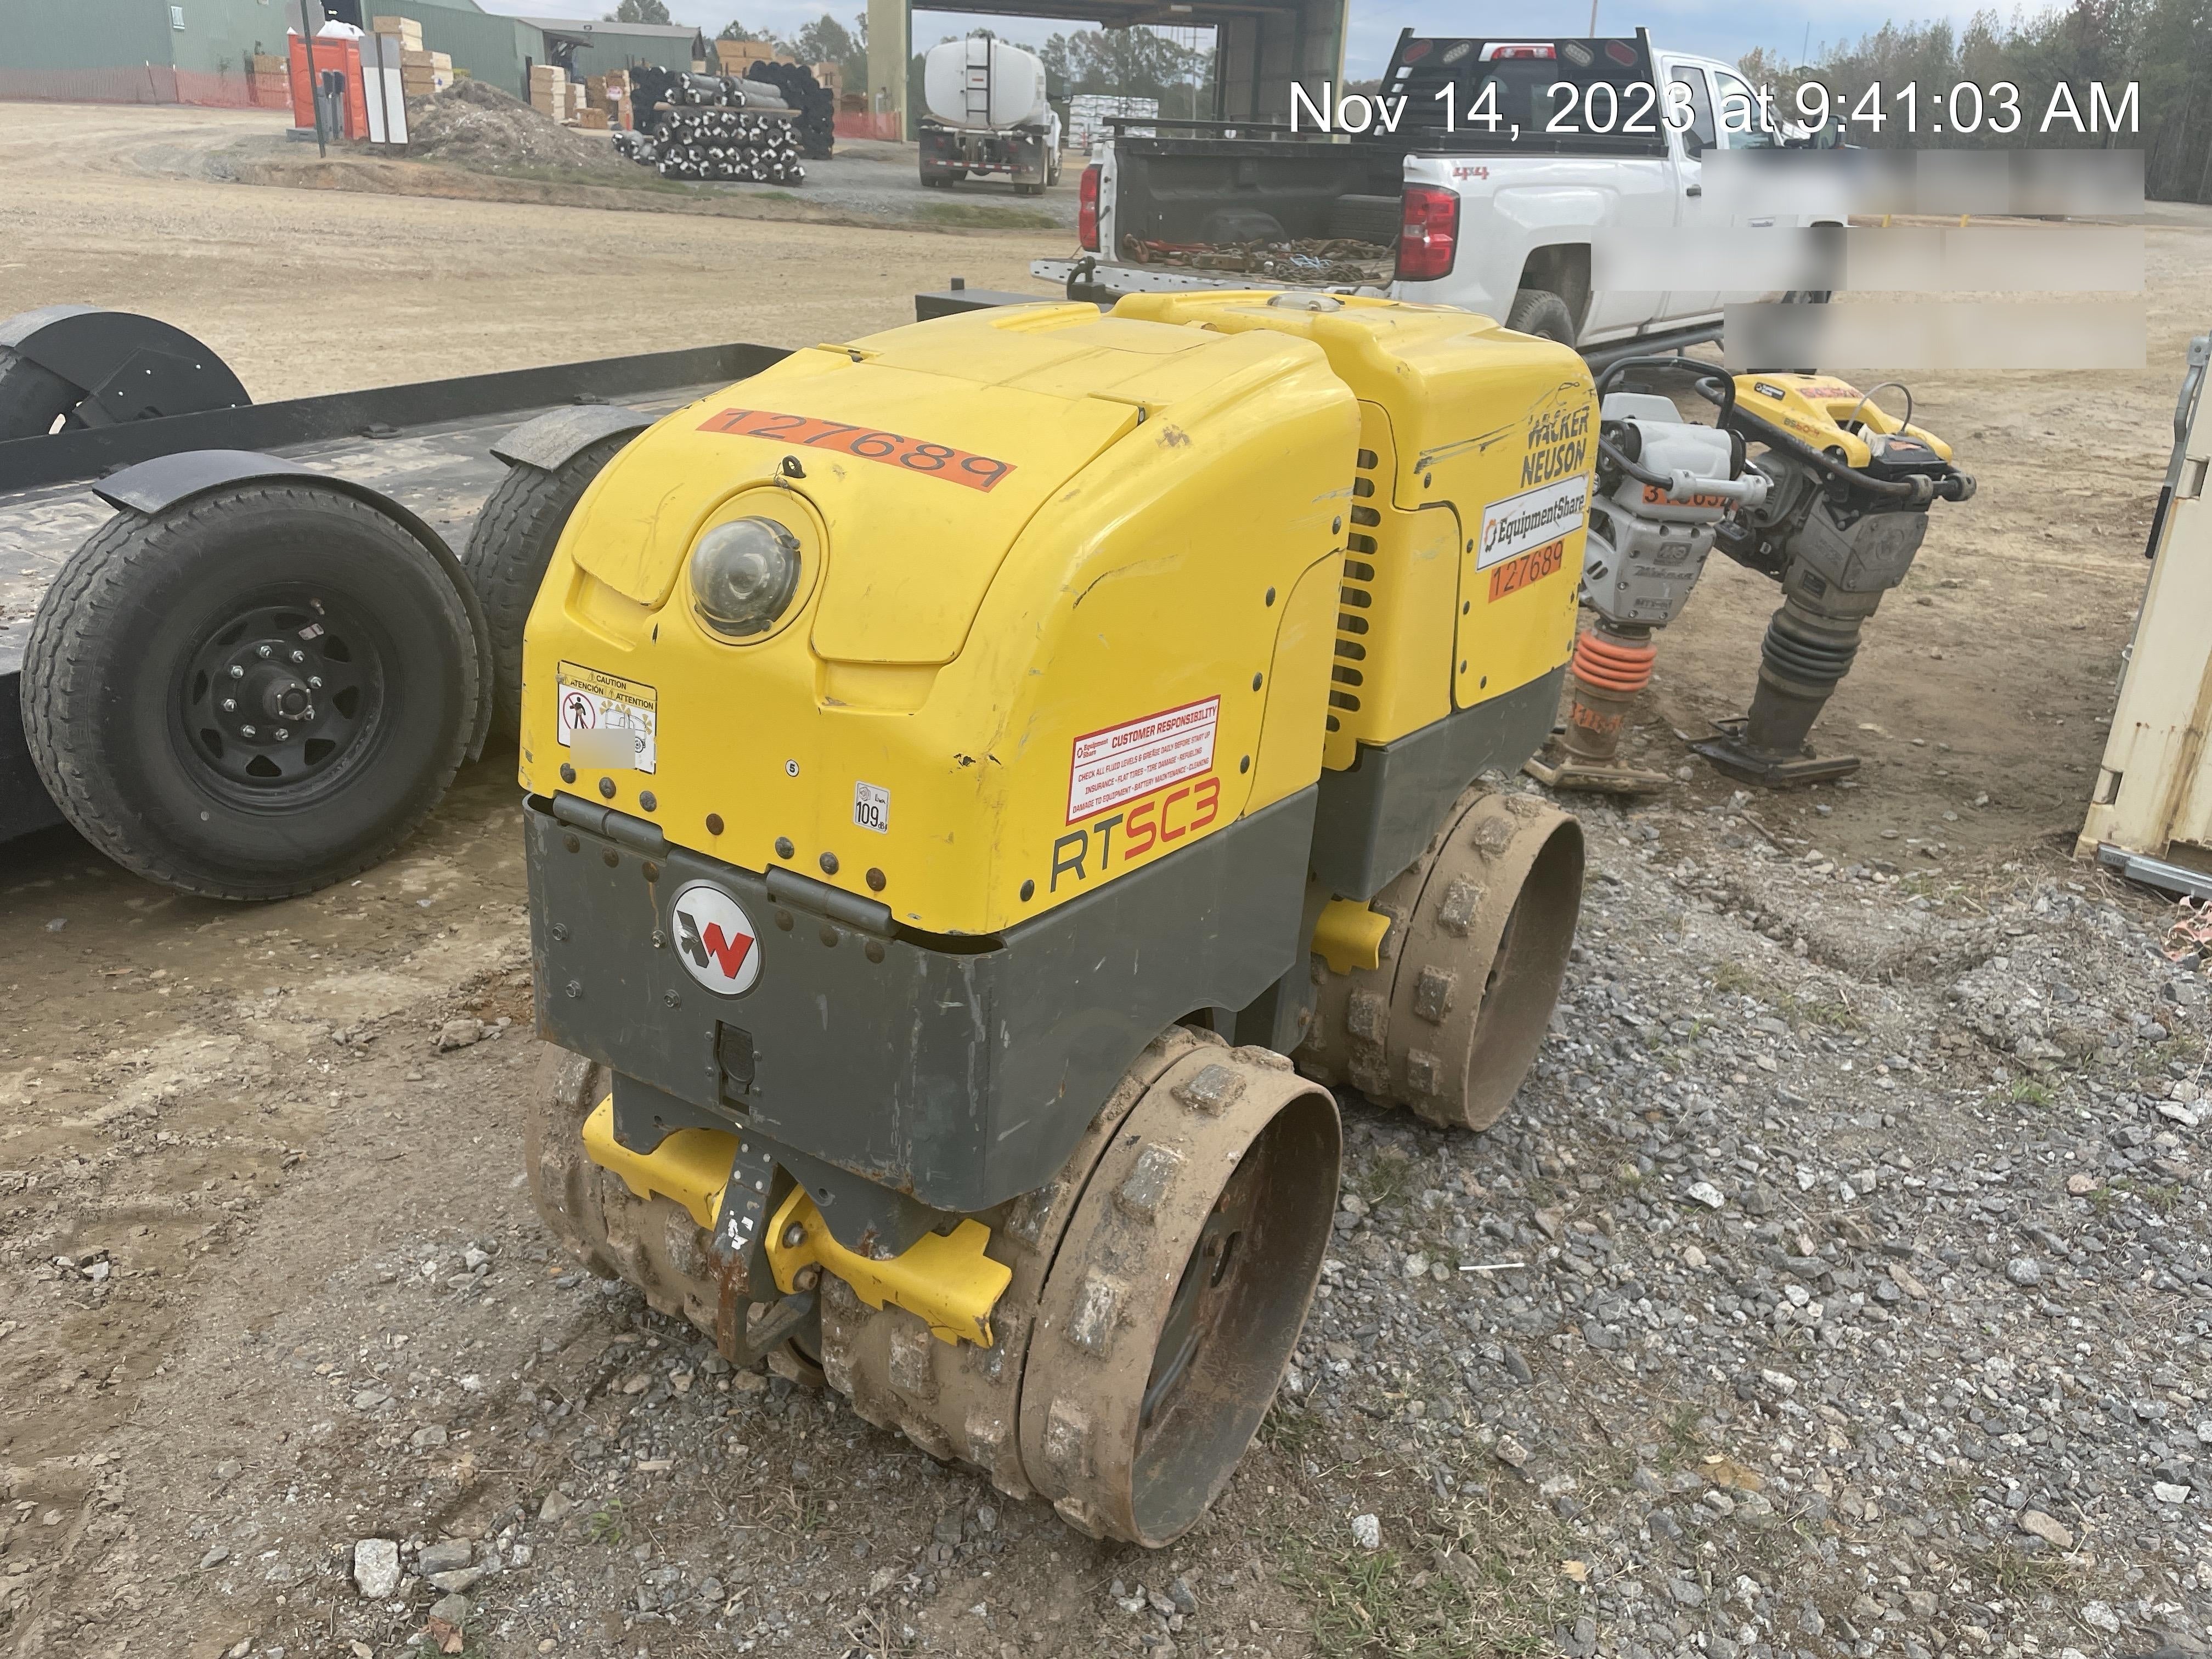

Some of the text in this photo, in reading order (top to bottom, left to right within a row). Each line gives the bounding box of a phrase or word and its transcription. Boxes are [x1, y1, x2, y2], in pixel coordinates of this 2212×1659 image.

[720, 409, 1008, 487] 127689
[1520, 437, 1587, 488] NEUSON
[1498, 494, 1584, 545] EquipmentShare
[1493, 540, 1563, 596] 127689
[596, 675, 627, 690] CAUTION
[616, 692, 653, 710] ATTENTION
[1084, 738, 1108, 751] Equipment
[1111, 705, 1217, 749] CUSTOMER RESPONSIBILITY
[789, 763, 795, 773] 5
[1078, 771, 1094, 782] CHECK
[1105, 761, 1120, 772] FLUID
[1121, 755, 1138, 768] LEVELS
[1143, 748, 1160, 760] GREASE
[1161, 743, 1174, 754] DAILY
[1175, 738, 1190, 749] BEFORE
[1191, 733, 1204, 743] START
[1205, 731, 1210, 739] UP
[1083, 749, 1096, 758] Share
[1085, 777, 1114, 794] INSURANCE
[1118, 773, 1129, 783] FLAT
[1130, 768, 1143, 778] TIRES
[1158, 756, 1177, 769] DAMAGE
[1180, 747, 1202, 760] REFUELING
[1073, 758, 1209, 813] DAMAGE TO EQUIPMENT BATTERY MAINTENANCE CLEANING
[856, 801, 879, 827] 109
[1050, 777, 1220, 893] RTSC3
